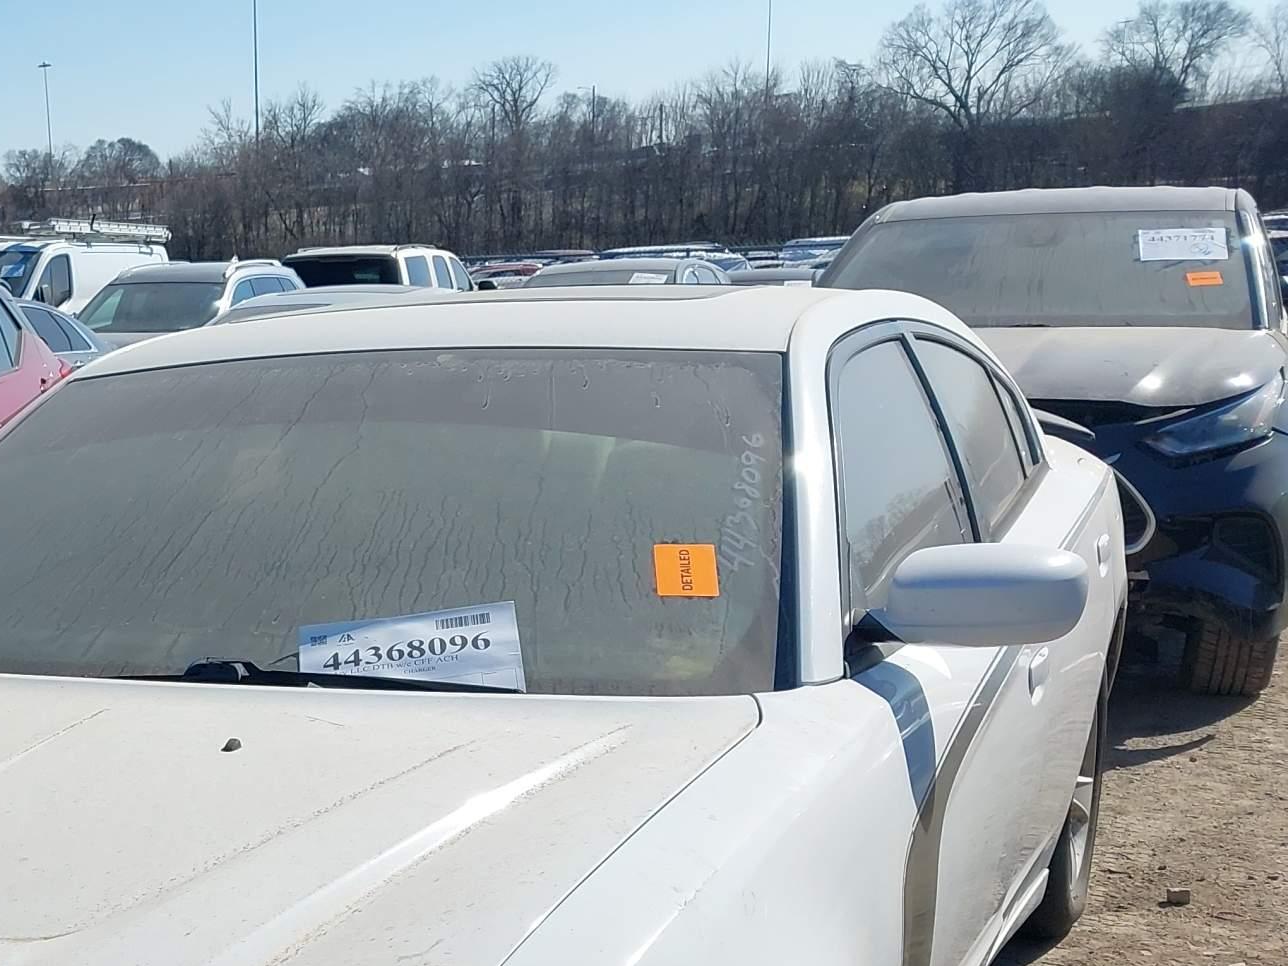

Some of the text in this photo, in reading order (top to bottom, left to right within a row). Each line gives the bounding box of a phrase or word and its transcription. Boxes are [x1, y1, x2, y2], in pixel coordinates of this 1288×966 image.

[679, 549, 694, 591] DETAILED
[322, 631, 491, 671] 44368096
[436, 654, 459, 664] ACH
